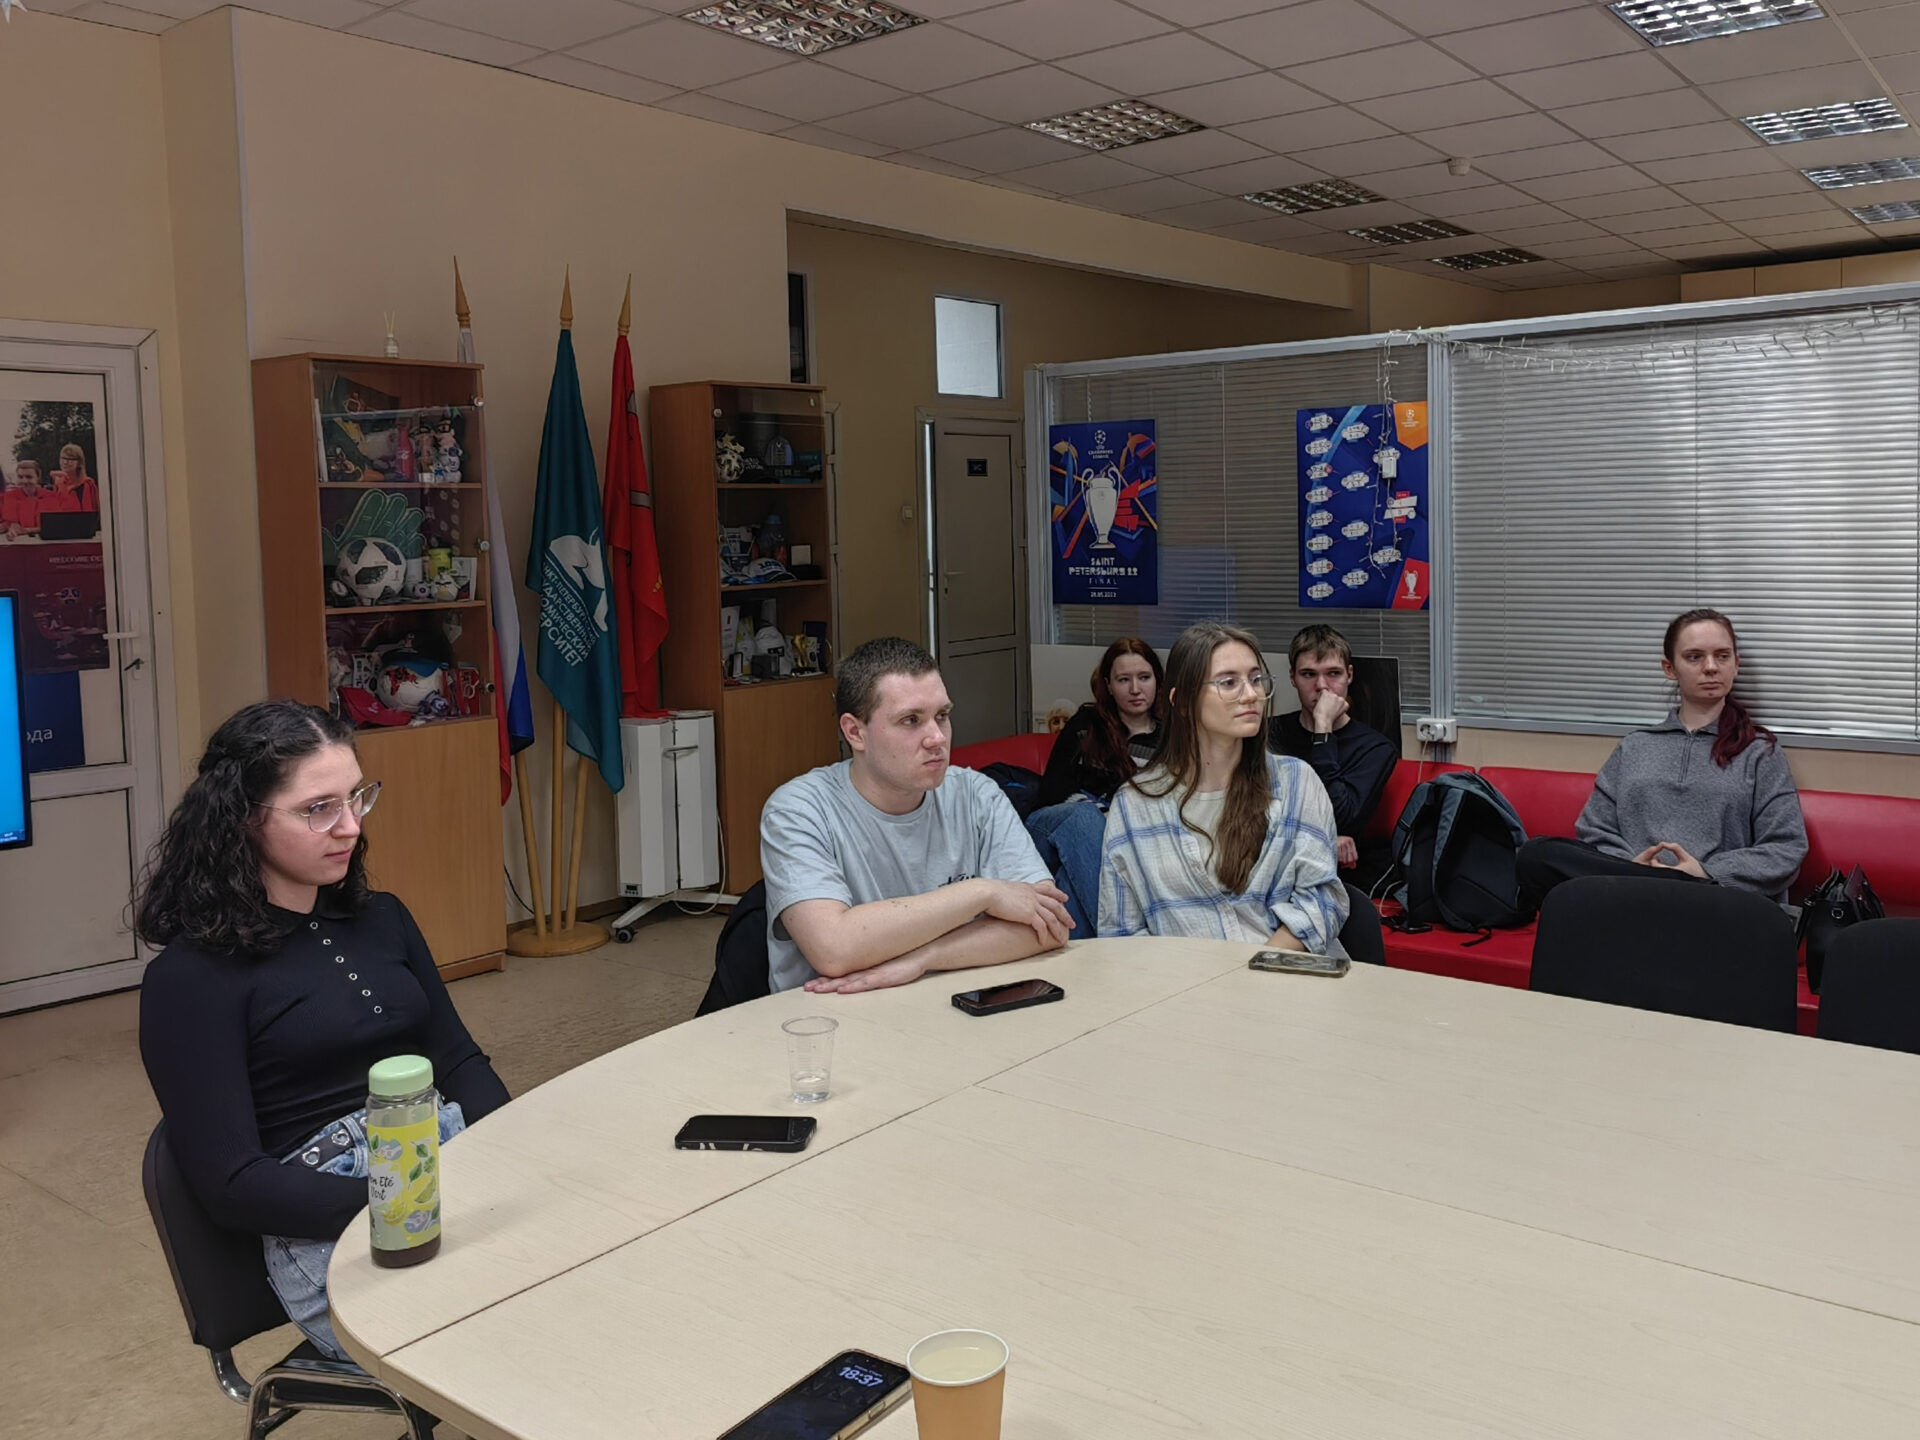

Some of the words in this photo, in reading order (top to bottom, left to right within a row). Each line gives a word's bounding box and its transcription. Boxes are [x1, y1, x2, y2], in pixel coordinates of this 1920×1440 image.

[1090, 557, 1115, 566] SAINT
[1088, 577, 1118, 585] FINAL
[839, 1366, 884, 1387] 18:37
